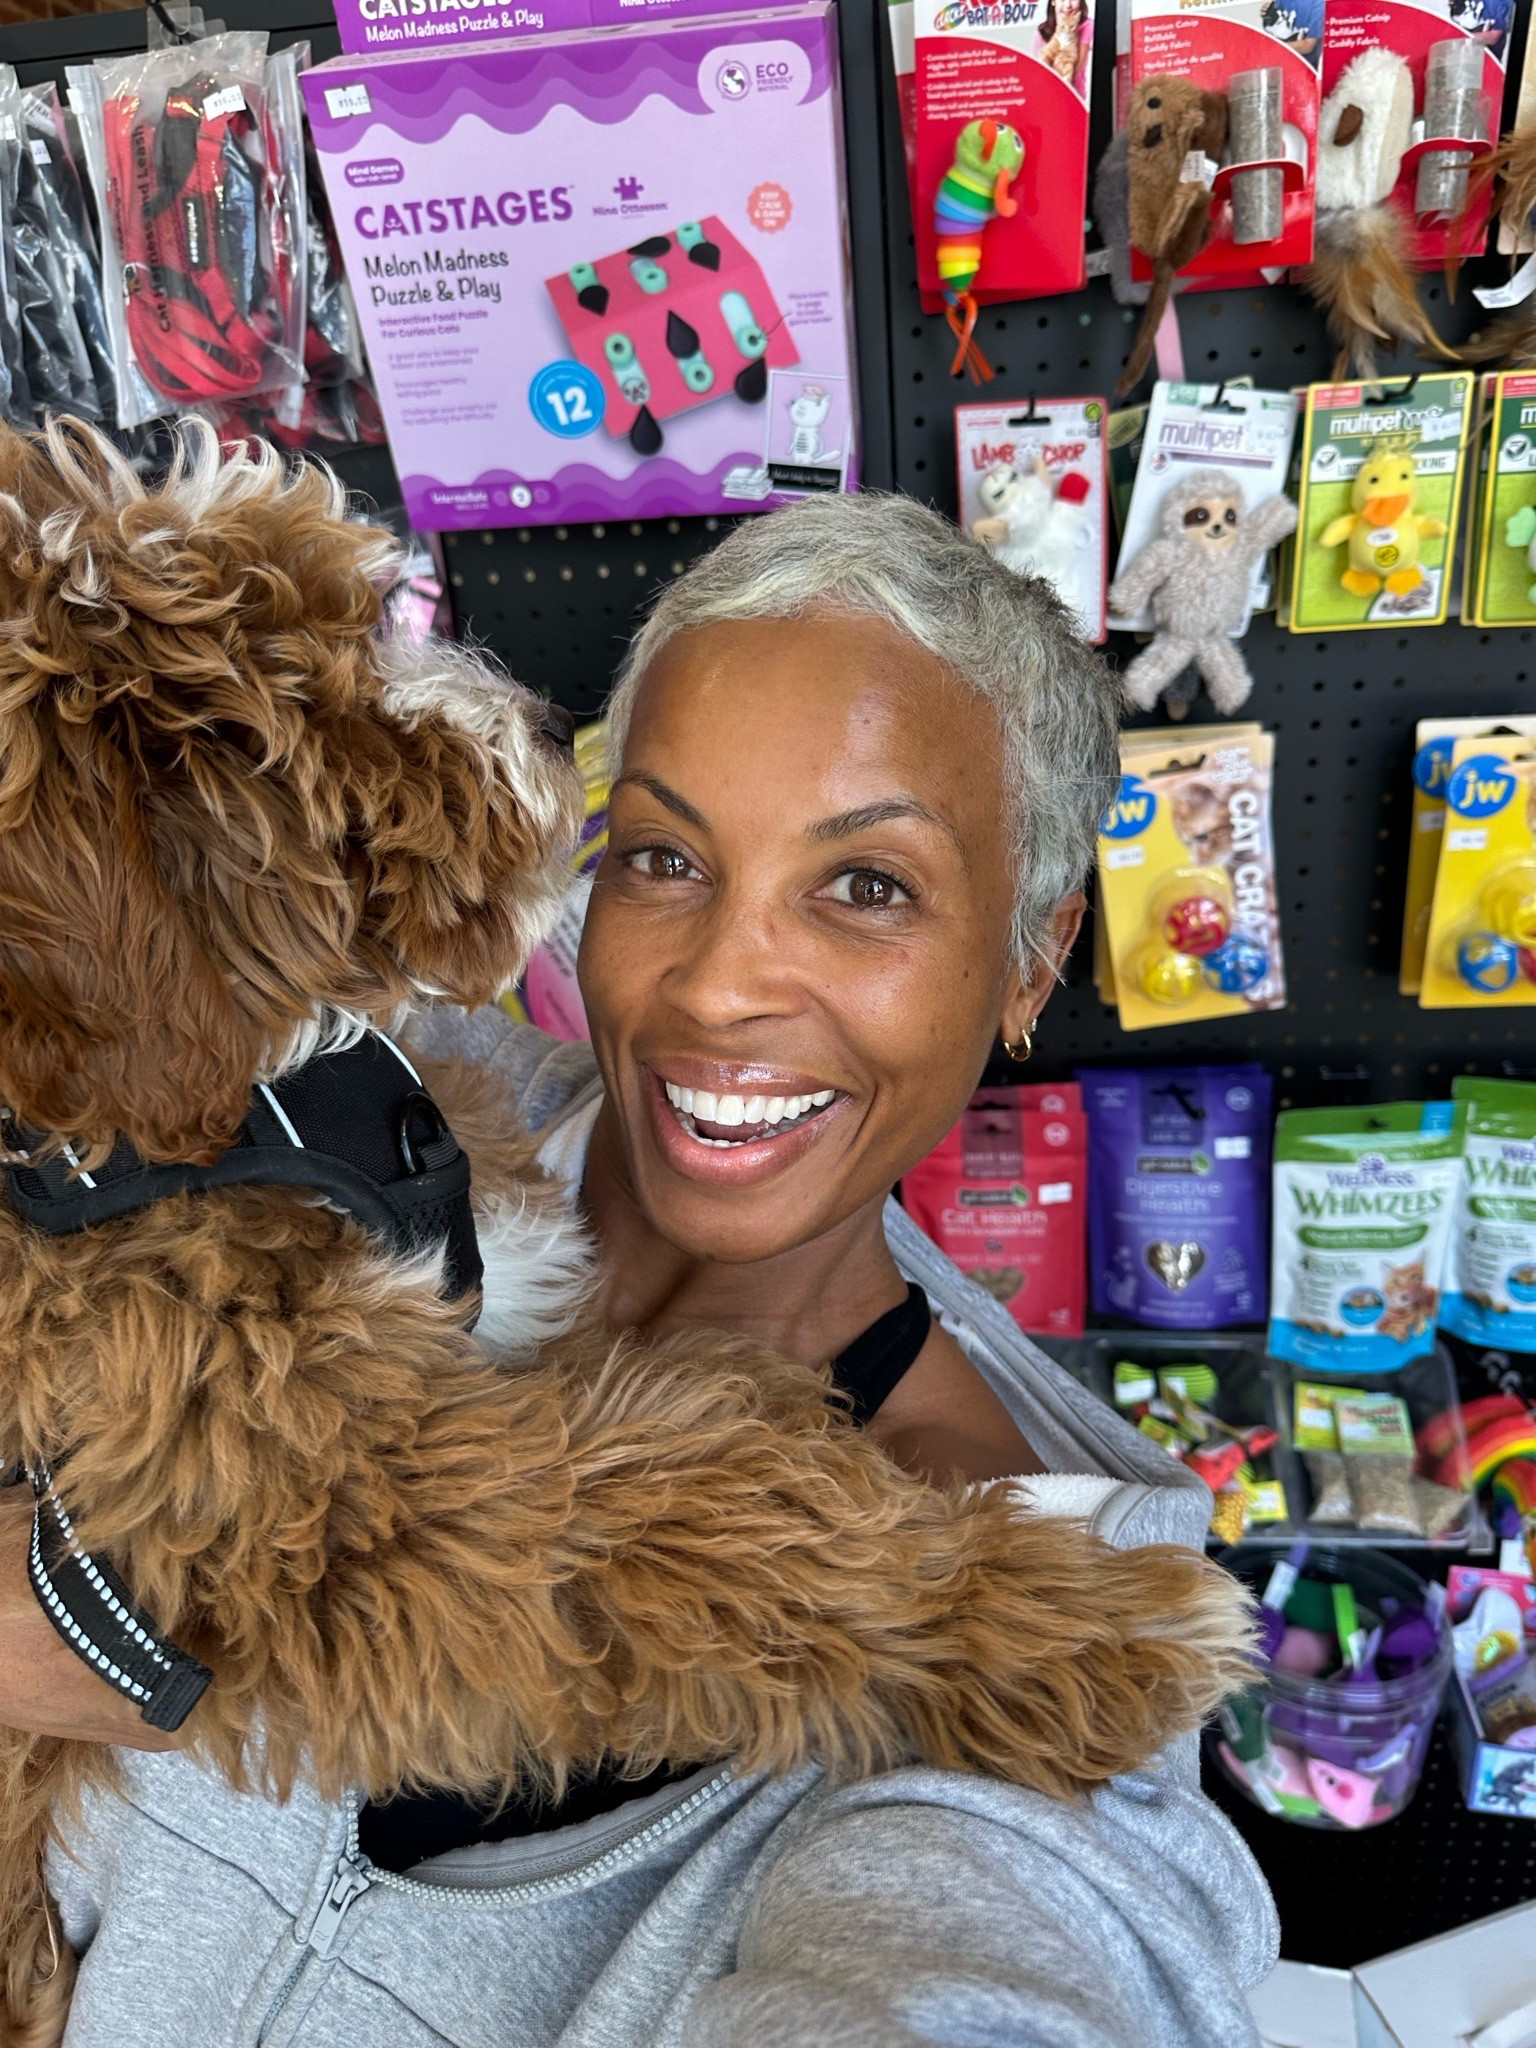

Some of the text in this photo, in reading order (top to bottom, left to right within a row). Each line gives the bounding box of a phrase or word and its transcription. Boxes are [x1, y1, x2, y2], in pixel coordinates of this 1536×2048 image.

[365, 9, 544, 43] Melon Madness Puzzle & Play
[1144, 19, 1199, 33] Premium Catnip
[1329, 13, 1391, 27] Premium Catnip
[1144, 32, 1177, 43] Refillable
[1329, 27, 1365, 37] Refillable
[1144, 40, 1191, 54] Cuddly Fabric
[1328, 36, 1381, 50] Cuddly Fabric
[1189, 55, 1199, 64] de
[756, 63, 789, 78] ECO
[756, 75, 794, 86] FRIENDLY
[757, 84, 789, 93] MATERIAL
[347, 164, 400, 177] Mind Games
[354, 186, 573, 240] CATSTAGES
[592, 205, 619, 217] Nina
[620, 202, 668, 213] Ottosson
[131, 125, 171, 332] Cat Harness and Leash
[362, 248, 509, 280] Melon Madness
[371, 276, 502, 307] Puzzle & Play
[379, 310, 488, 327] Interactive Food Puzzle
[382, 324, 460, 340] For Curious Cats
[546, 386, 593, 426] 12
[1329, 409, 1402, 436] multipet
[1159, 420, 1244, 451] multipet
[972, 443, 1086, 471] LAMB CHOP
[1458, 770, 1508, 809] jw
[1228, 790, 1260, 855] CAT
[1326, 1170, 1416, 1188] WELLNESS
[1125, 1177, 1224, 1198] Digestive
[1140, 1198, 1211, 1213] Health
[942, 1209, 1048, 1225] Cat Health
